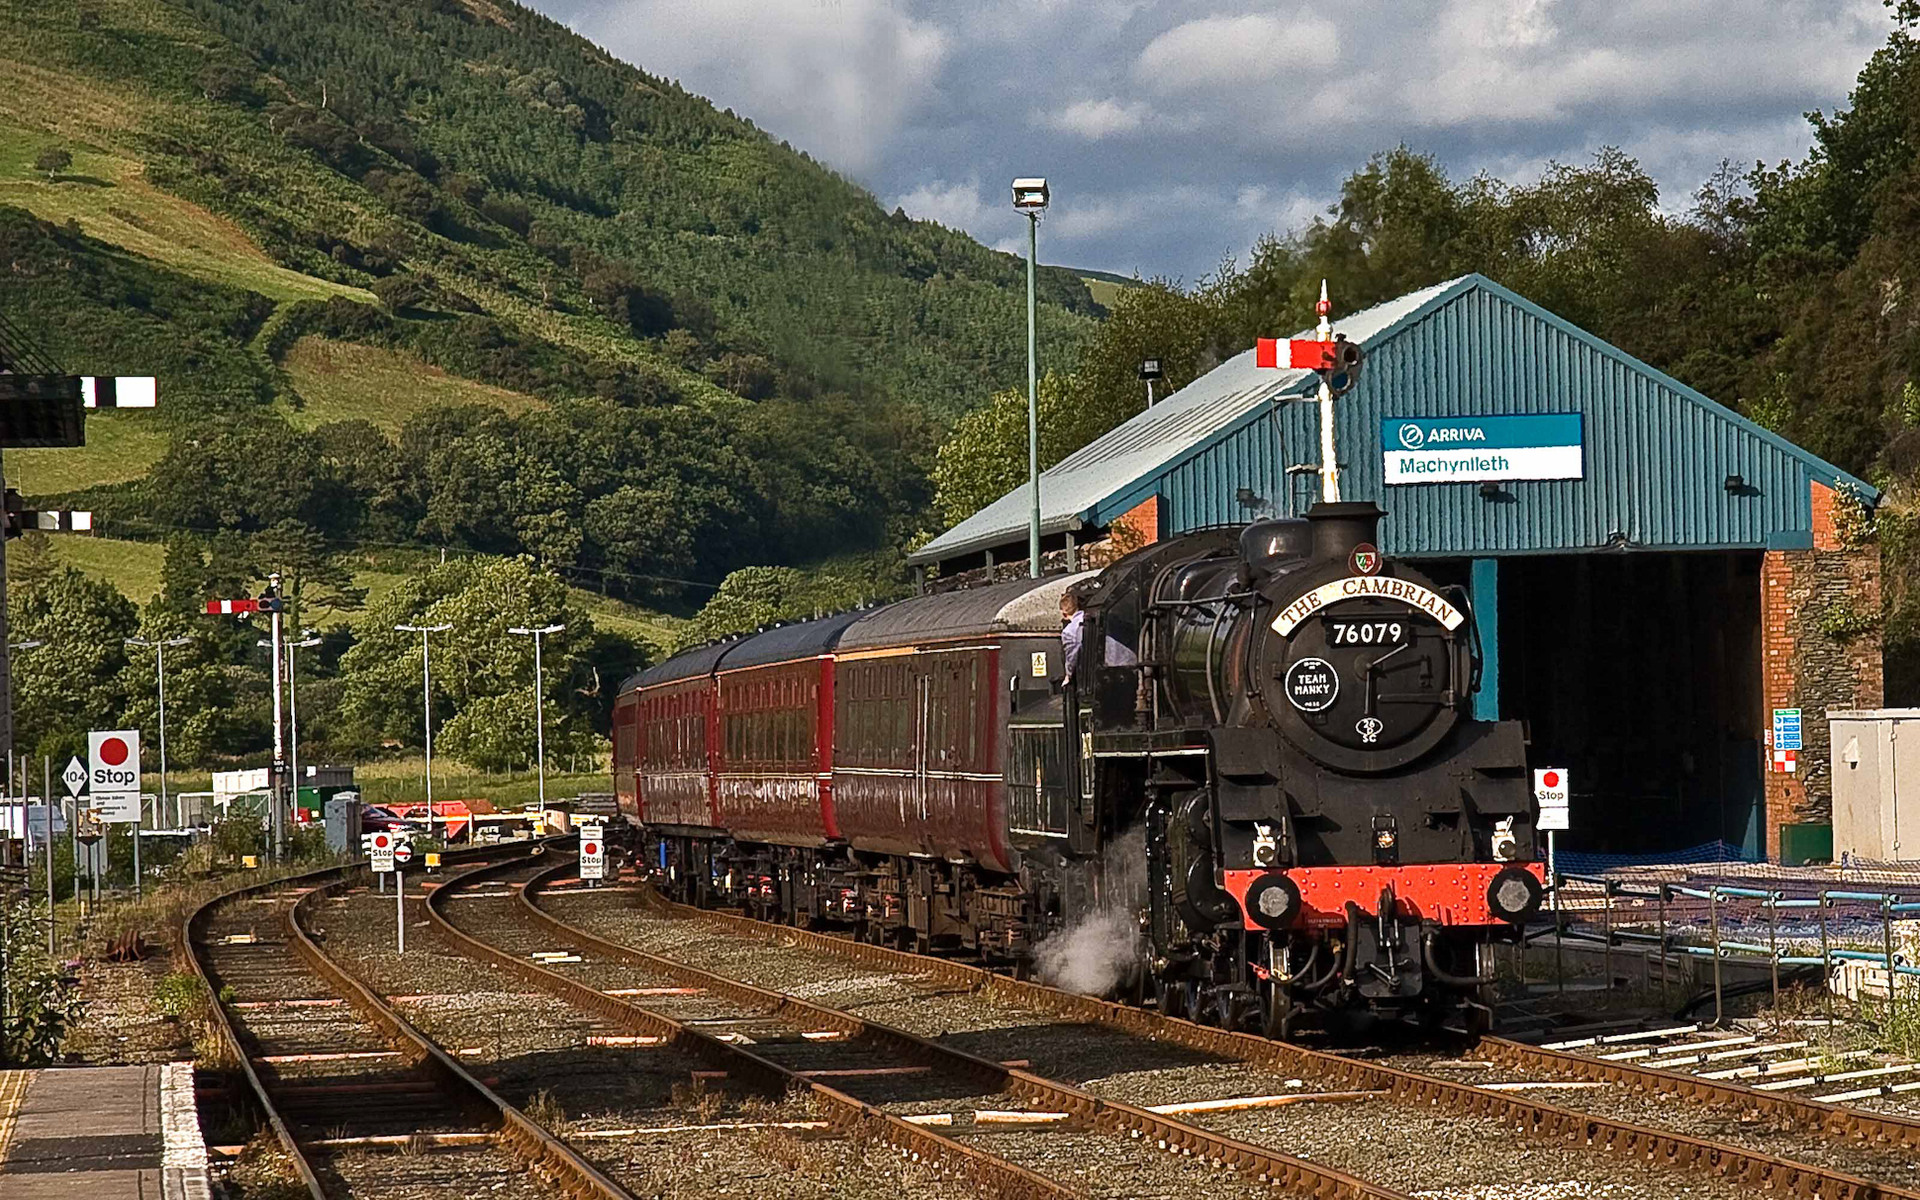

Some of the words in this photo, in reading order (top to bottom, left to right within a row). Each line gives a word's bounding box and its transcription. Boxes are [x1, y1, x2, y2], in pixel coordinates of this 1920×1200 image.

[1427, 427, 1486, 443] ARRIVA
[1399, 455, 1509, 475] Machynlleth
[1281, 592, 1322, 625] THE
[1342, 578, 1454, 622] CAMBRIAN
[1333, 622, 1402, 645] 76079
[1297, 673, 1327, 685] TEAM
[1294, 684, 1330, 696] MANKY
[65, 771, 85, 783] 104
[94, 768, 135, 787] Stop
[1539, 790, 1564, 801] Stop
[372, 849, 393, 857] Stop
[581, 855, 602, 864] Stop
